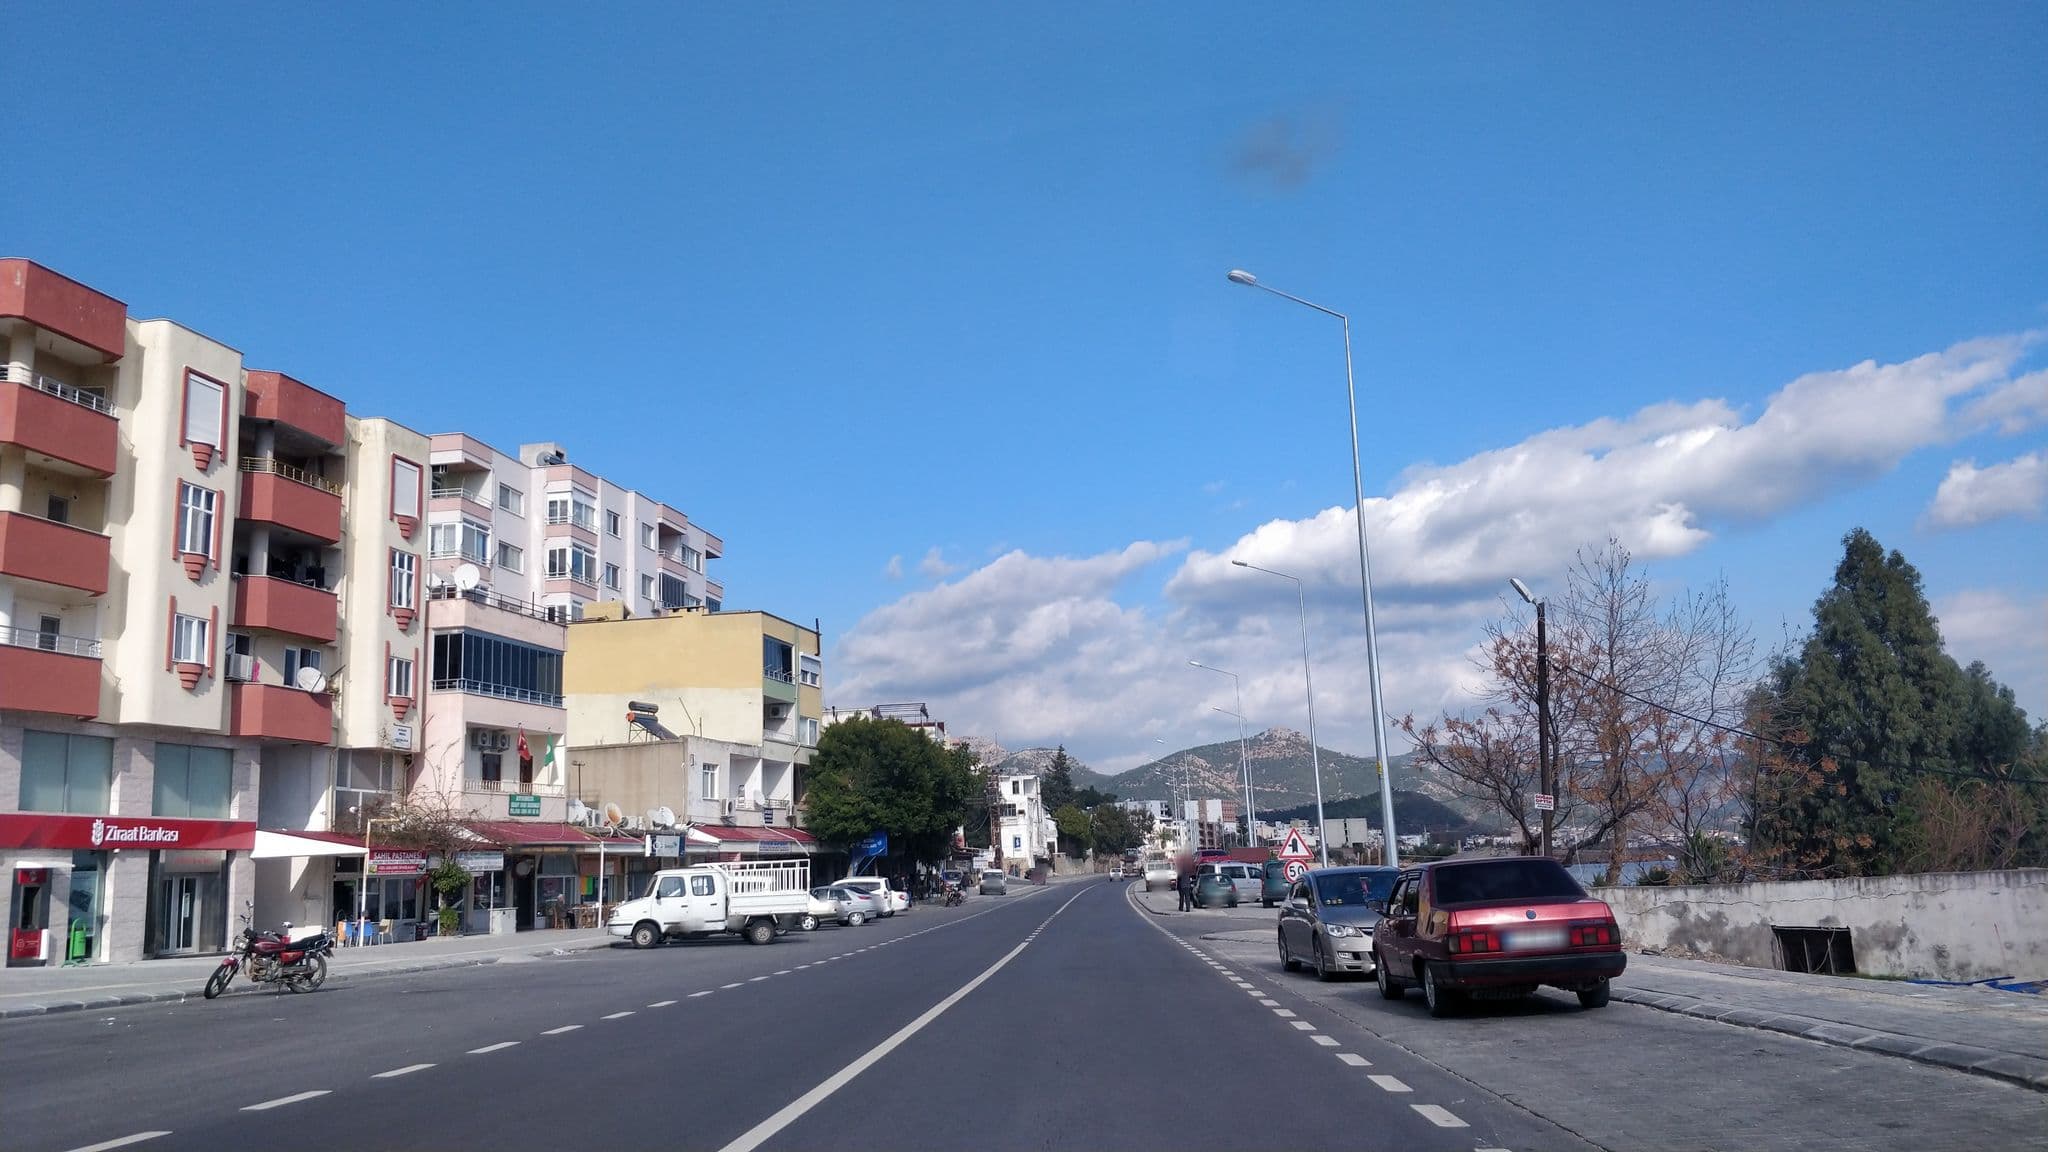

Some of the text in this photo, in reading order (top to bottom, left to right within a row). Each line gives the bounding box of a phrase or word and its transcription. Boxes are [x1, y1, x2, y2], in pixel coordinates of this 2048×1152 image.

[105, 825, 179, 842] Ziraat Bankası
[1289, 865, 1304, 878] 50
